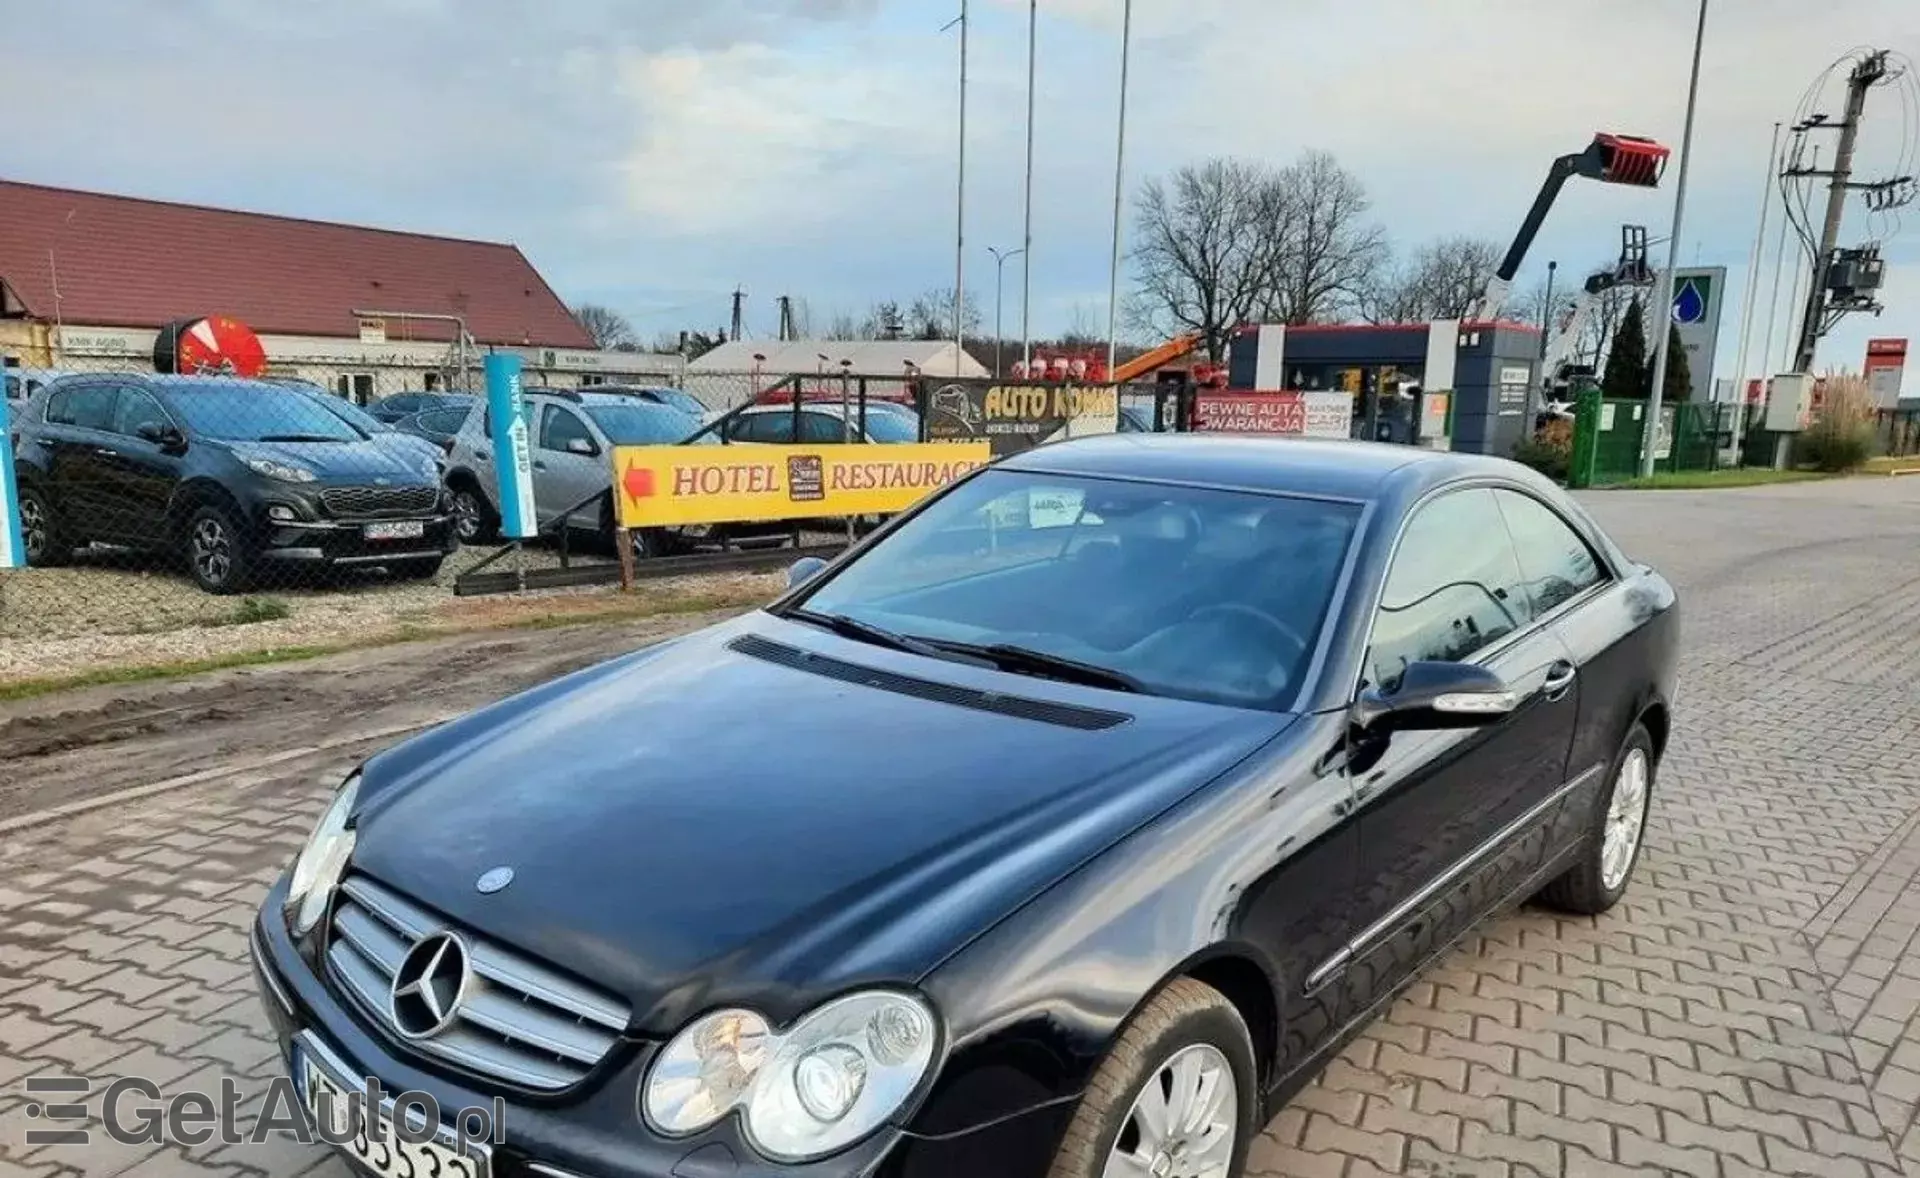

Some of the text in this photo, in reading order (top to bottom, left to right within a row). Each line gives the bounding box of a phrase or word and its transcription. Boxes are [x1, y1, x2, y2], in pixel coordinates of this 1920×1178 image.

[985, 386, 1047, 420] AUTO
[1200, 402, 1304, 417] PEWNE AUTA
[671, 464, 781, 496] HOTEL
